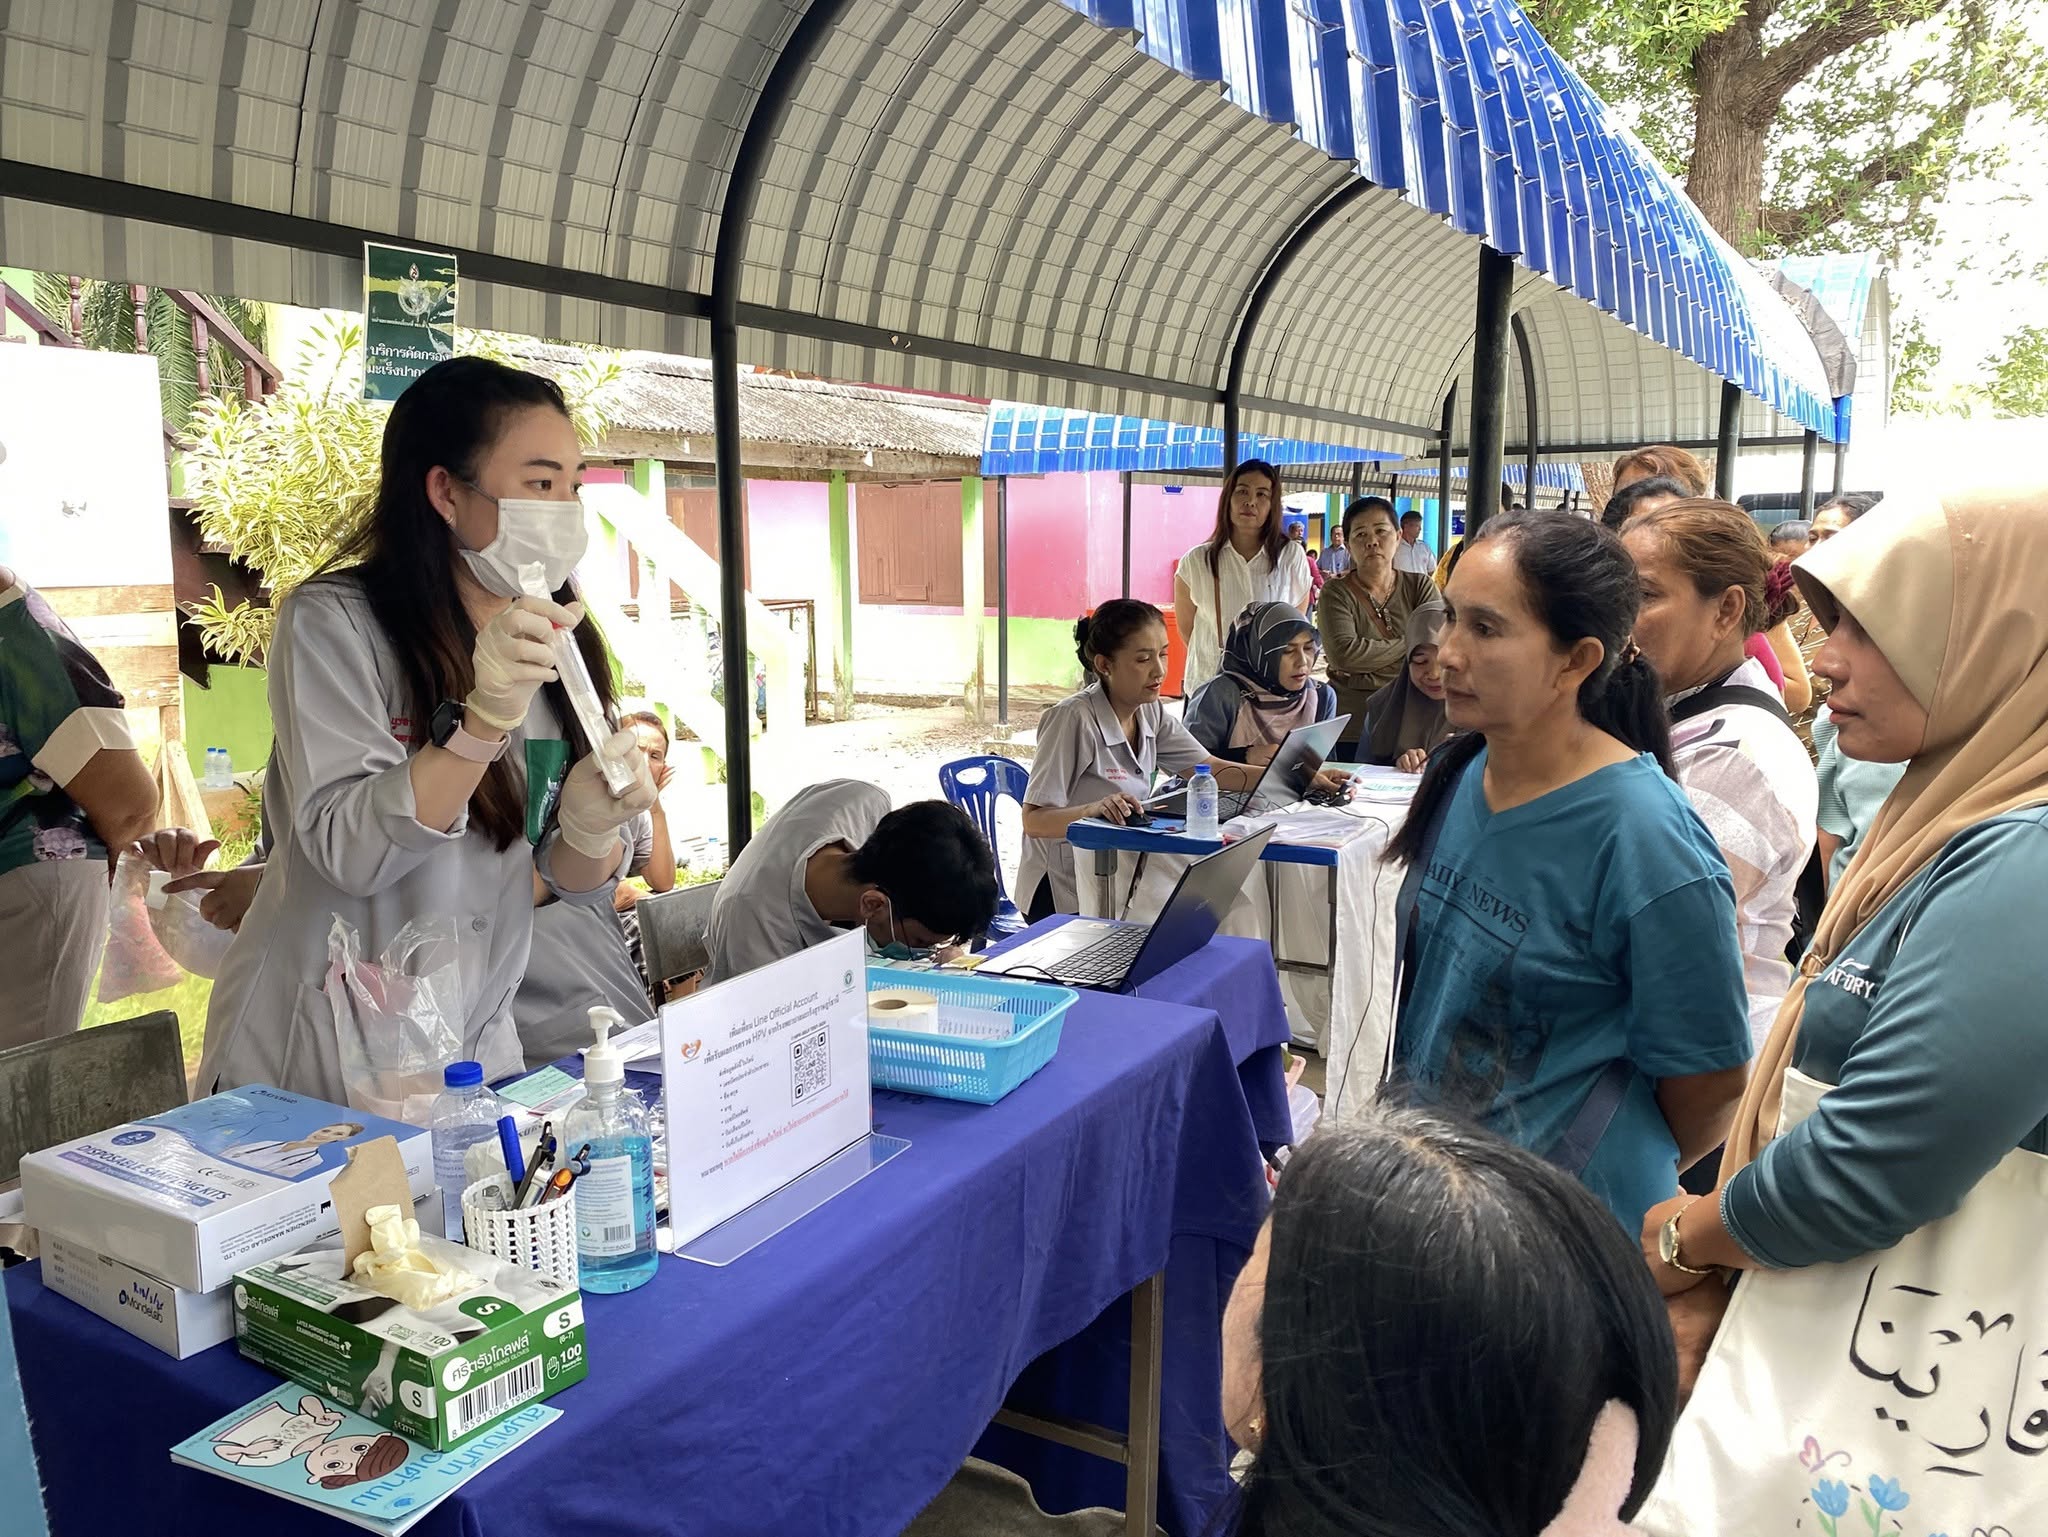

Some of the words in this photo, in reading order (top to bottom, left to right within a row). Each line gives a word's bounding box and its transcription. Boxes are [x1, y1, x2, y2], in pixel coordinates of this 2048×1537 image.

[370, 343, 450, 362] บริการคัดกรอง
[367, 361, 427, 378] มะเร็งปาก
[1425, 860, 1467, 893] AILY
[1468, 883, 1531, 933] NEWS
[753, 1013, 768, 1028] Line
[769, 1001, 793, 1020] Official
[793, 992, 818, 1010] Account
[751, 1028, 767, 1043] HPV
[76, 1144, 145, 1172] DISPOSABLE
[198, 1186, 232, 1200] KITS
[285, 1216, 317, 1234] SHENZHEN
[251, 1229, 285, 1249] MANDELAB
[476, 1303, 501, 1316] S
[559, 1311, 571, 1329] S
[429, 1335, 451, 1346] 100
[559, 1330, 575, 1345] (6-7)
[452, 1329, 530, 1382] ศรีตรังโกลฟส์
[560, 1343, 582, 1363] 100
[412, 1390, 422, 1408] S
[451, 1429, 458, 1439] 8
[463, 1407, 500, 1432] 859130
[503, 1387, 539, 1411] 619000
[438, 1407, 545, 1477] สมุดบันทึก
[350, 1449, 443, 1507] จเต้านม
